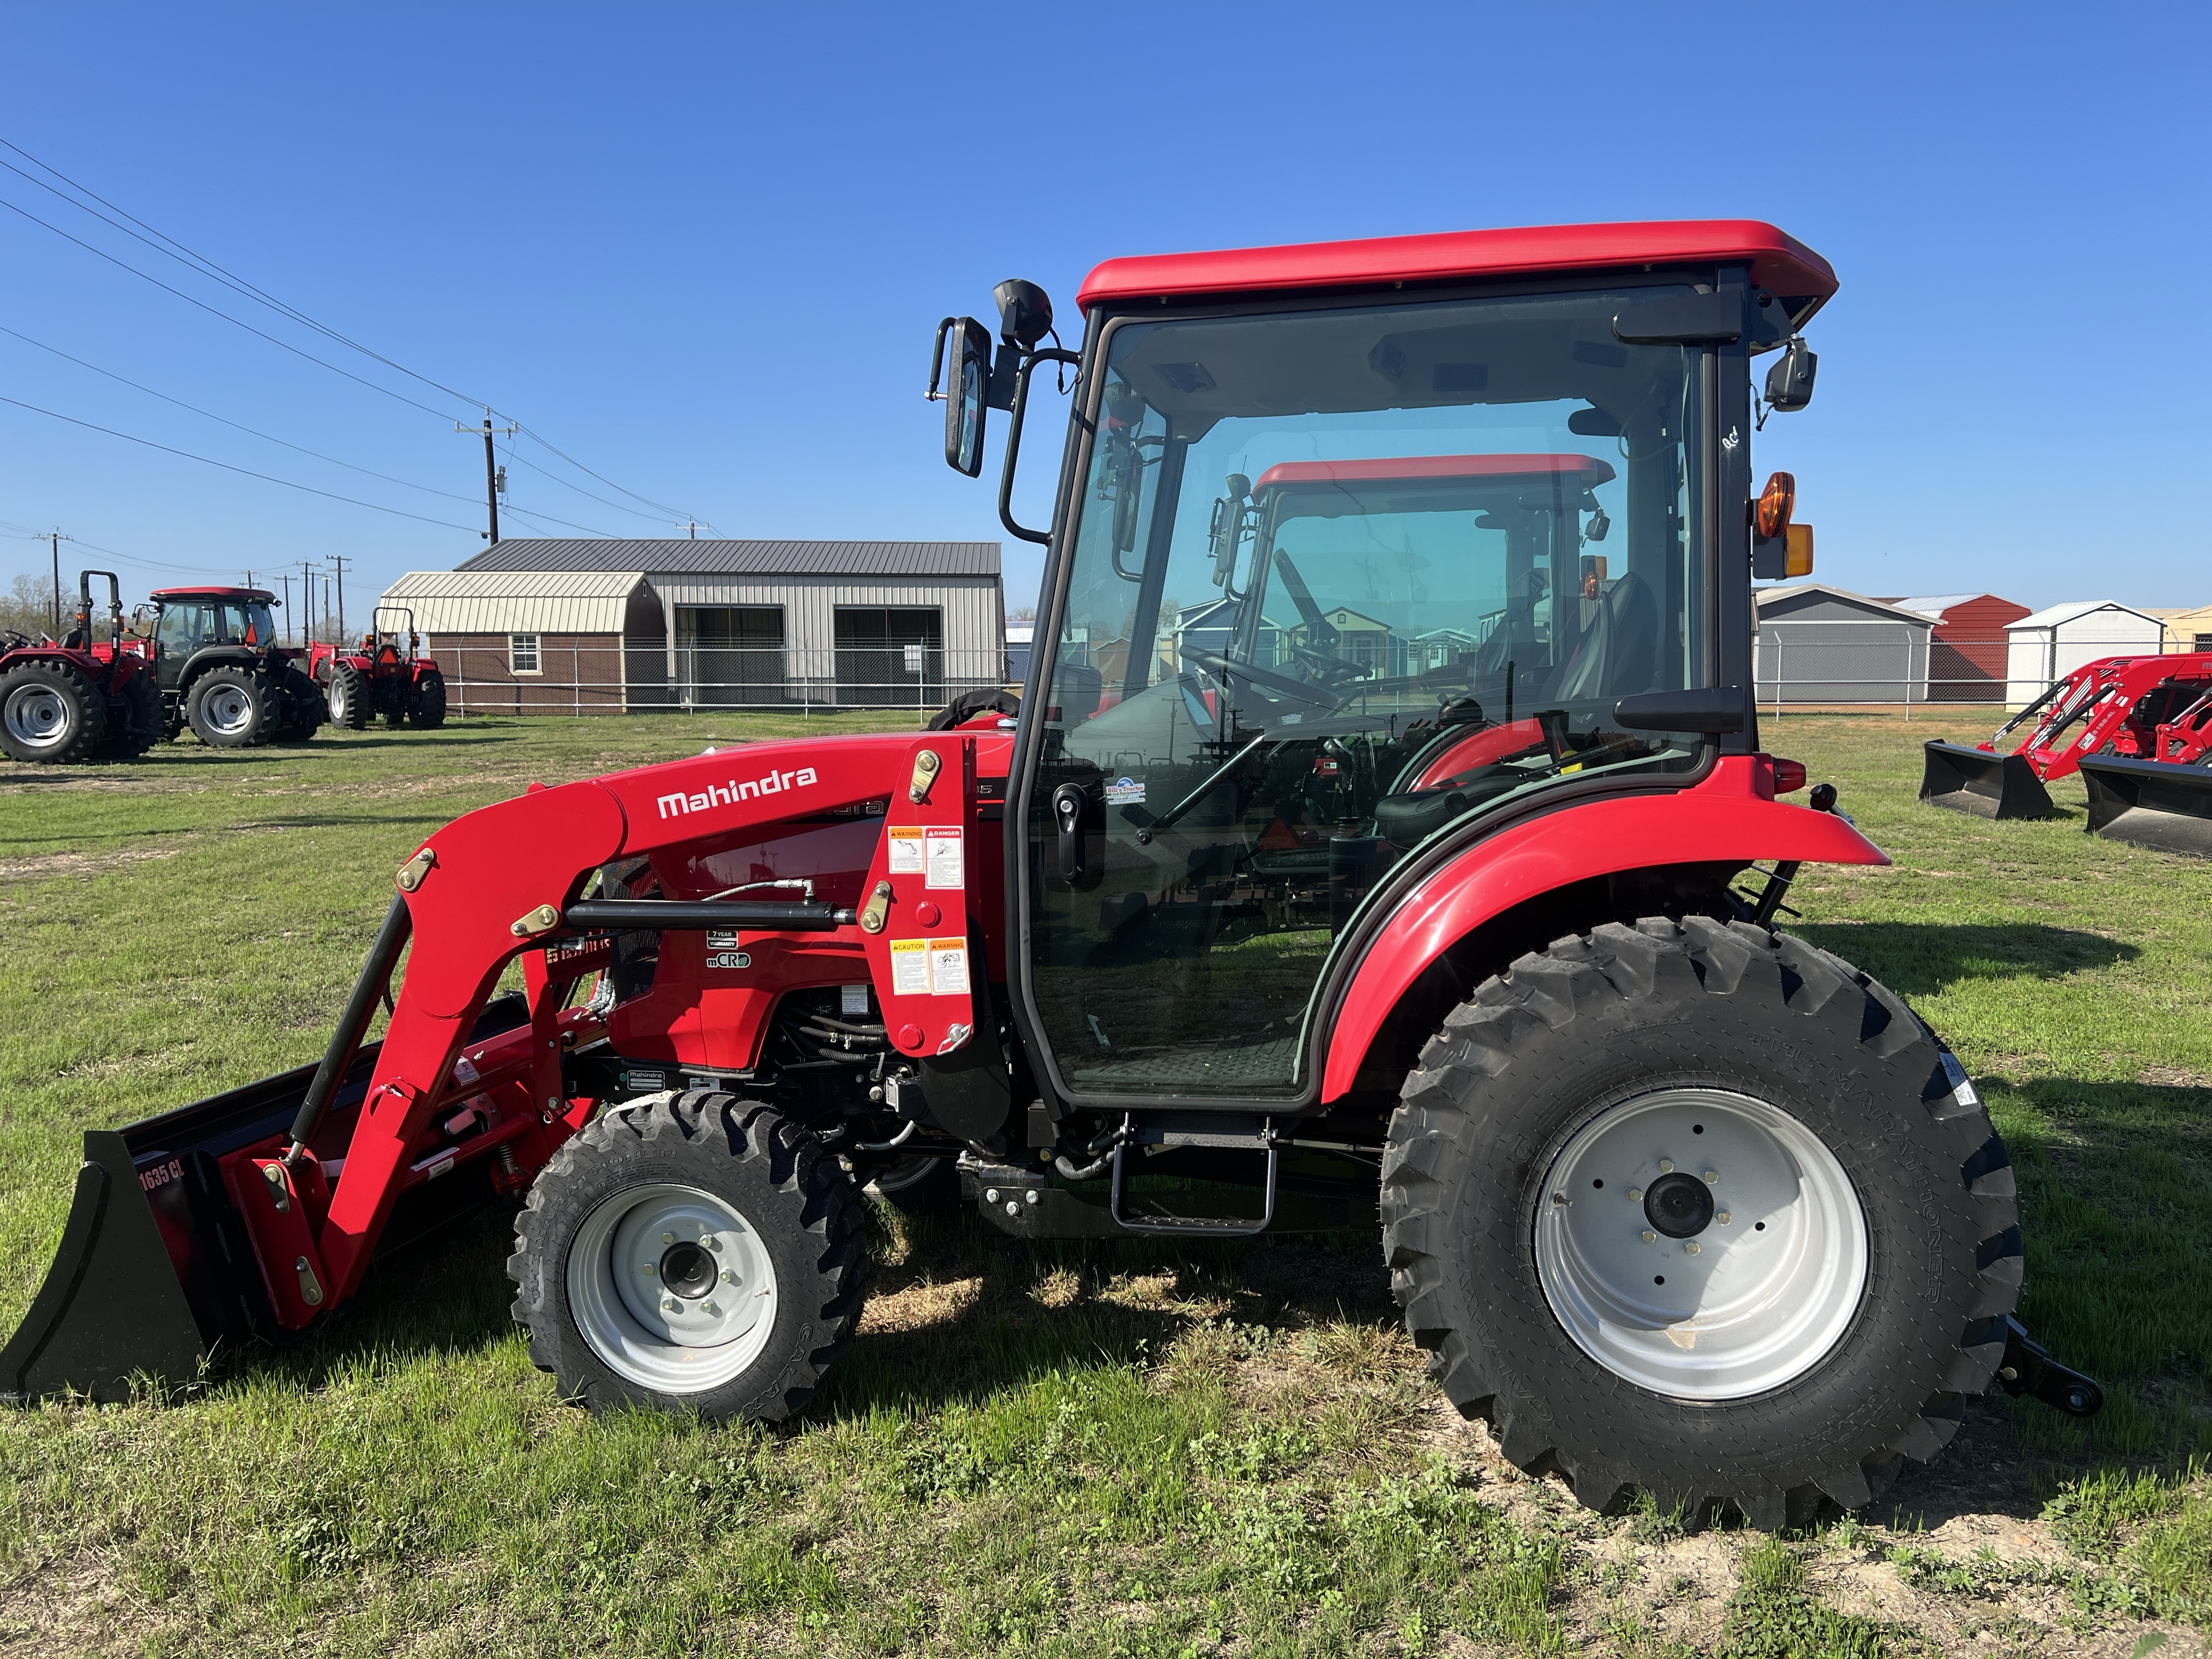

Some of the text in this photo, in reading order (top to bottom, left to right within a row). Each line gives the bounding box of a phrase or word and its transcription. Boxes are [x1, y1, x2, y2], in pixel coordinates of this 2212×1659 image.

[656, 766, 818, 820] Mahindra
[138, 1159, 185, 1192] 1635 CL
[1745, 1031, 1945, 1305] THE MARATHONER
[728, 1322, 814, 1417] GALAX
